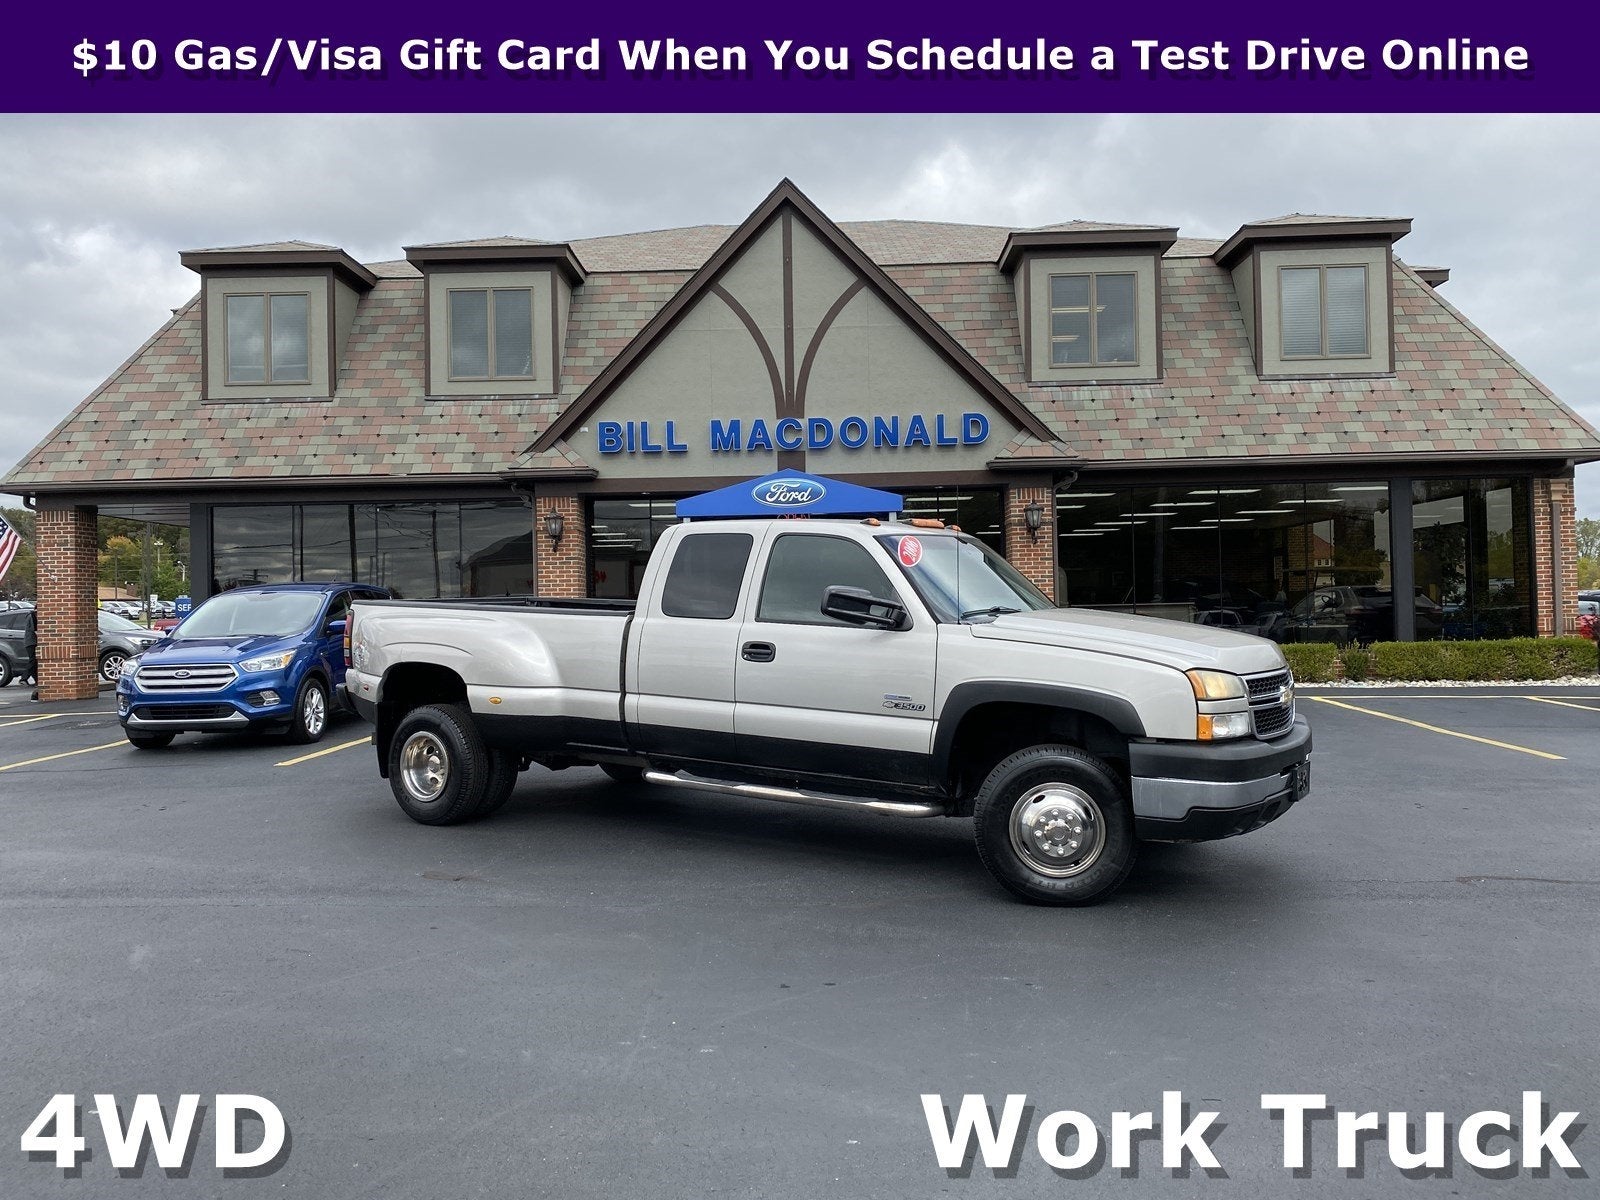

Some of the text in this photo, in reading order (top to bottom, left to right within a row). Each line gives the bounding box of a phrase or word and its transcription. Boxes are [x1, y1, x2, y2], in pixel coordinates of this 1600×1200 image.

[597, 411, 991, 453] BILL MACDONALD
[765, 482, 812, 502] Ford
[895, 702, 926, 711] 3500
